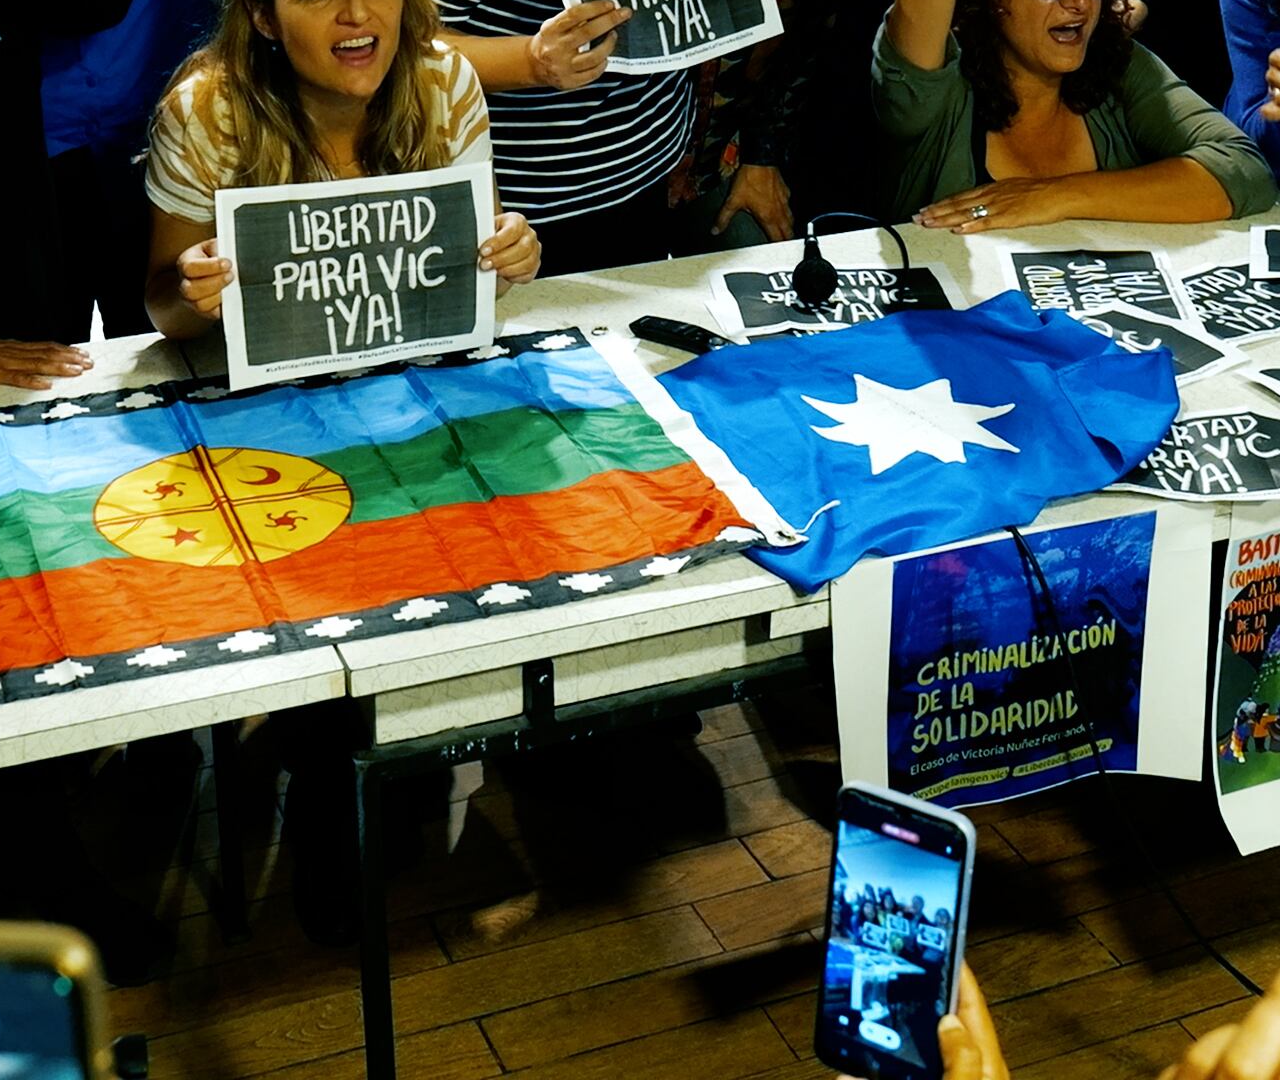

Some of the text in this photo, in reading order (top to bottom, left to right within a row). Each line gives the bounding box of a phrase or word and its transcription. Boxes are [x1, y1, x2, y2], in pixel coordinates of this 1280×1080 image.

[272, 246, 447, 301] PARA VIC
[324, 291, 405, 356] ¡YA!
[1154, 458, 1249, 495] ¡YA!
[1248, 585, 1257, 598] A
[1236, 615, 1267, 634] DE LA
[914, 682, 975, 720] DE LA
[910, 736, 1041, 775] El caso de Victoria Nuñez
